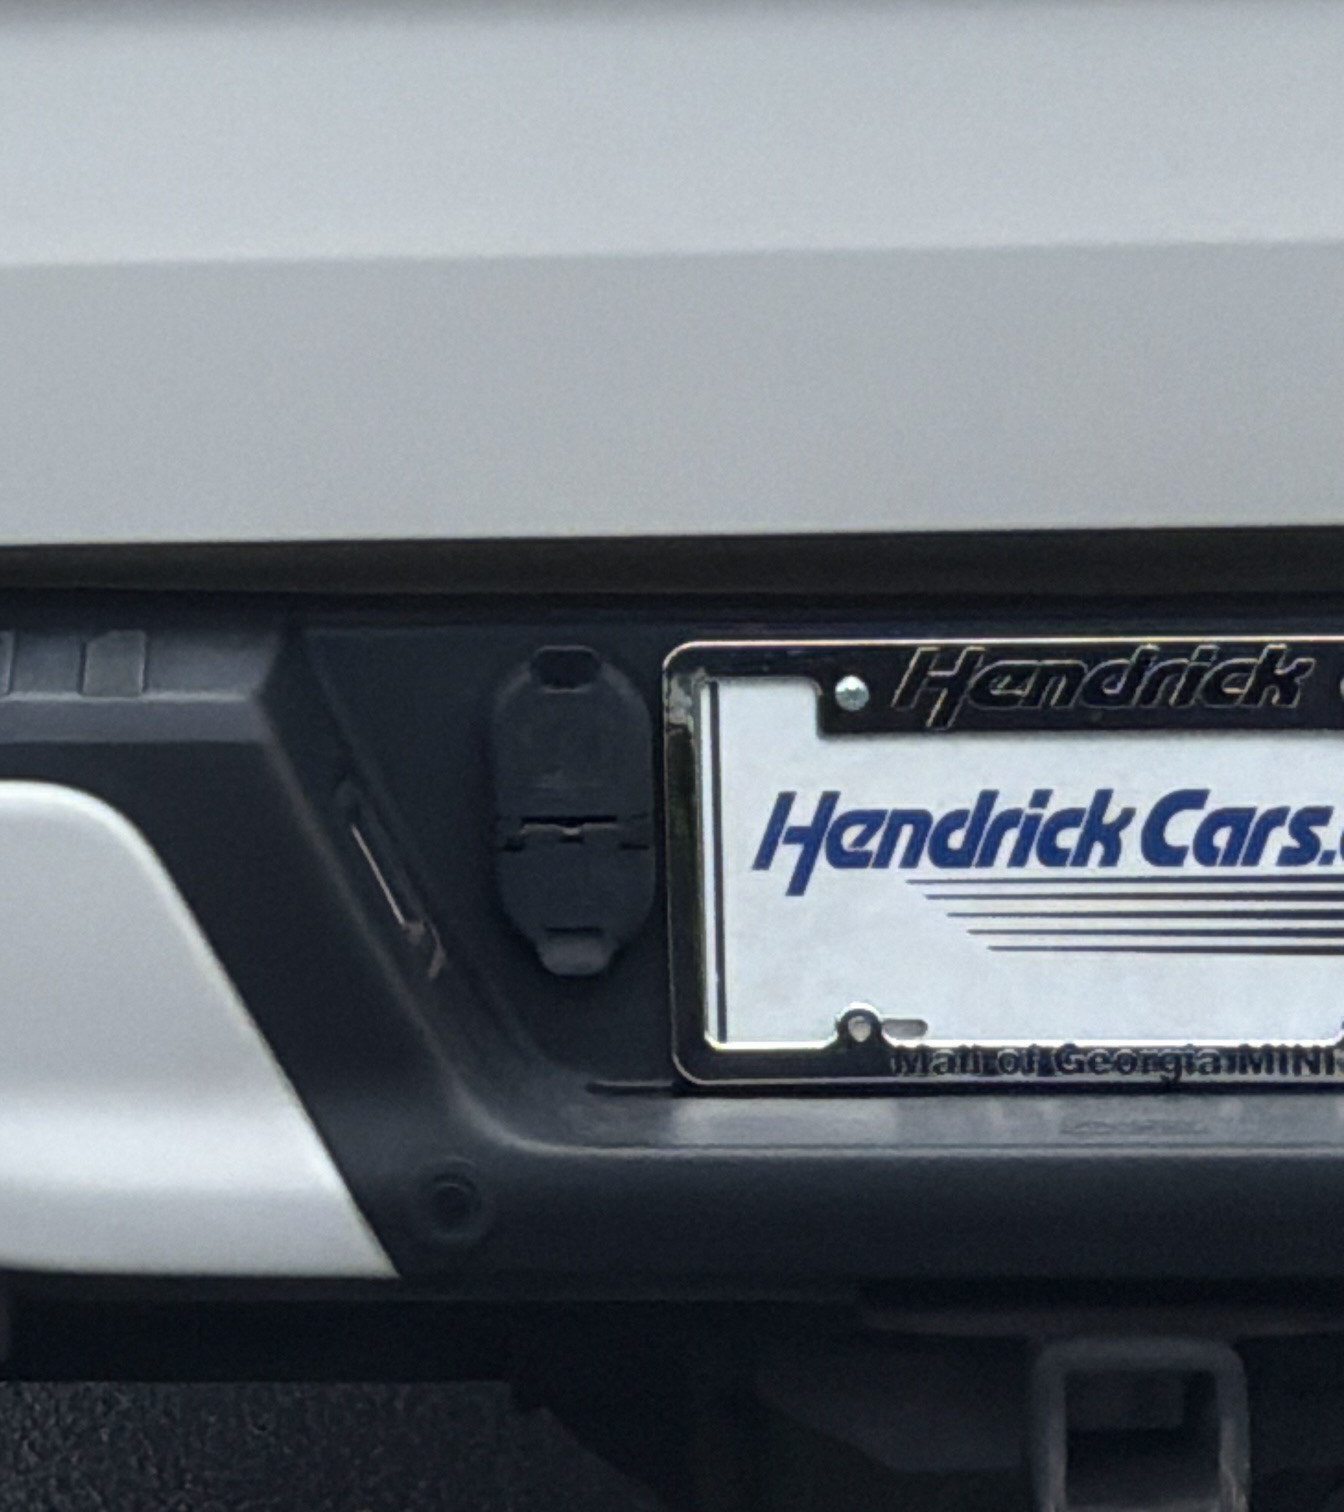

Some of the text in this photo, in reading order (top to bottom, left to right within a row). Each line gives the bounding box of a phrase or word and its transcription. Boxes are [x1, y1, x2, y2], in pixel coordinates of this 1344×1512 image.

[891, 644, 1316, 730] Hendrick
[1140, 788, 1344, 868] Cars.
[891, 1043, 1337, 1085] Mall of Georgia MINI
